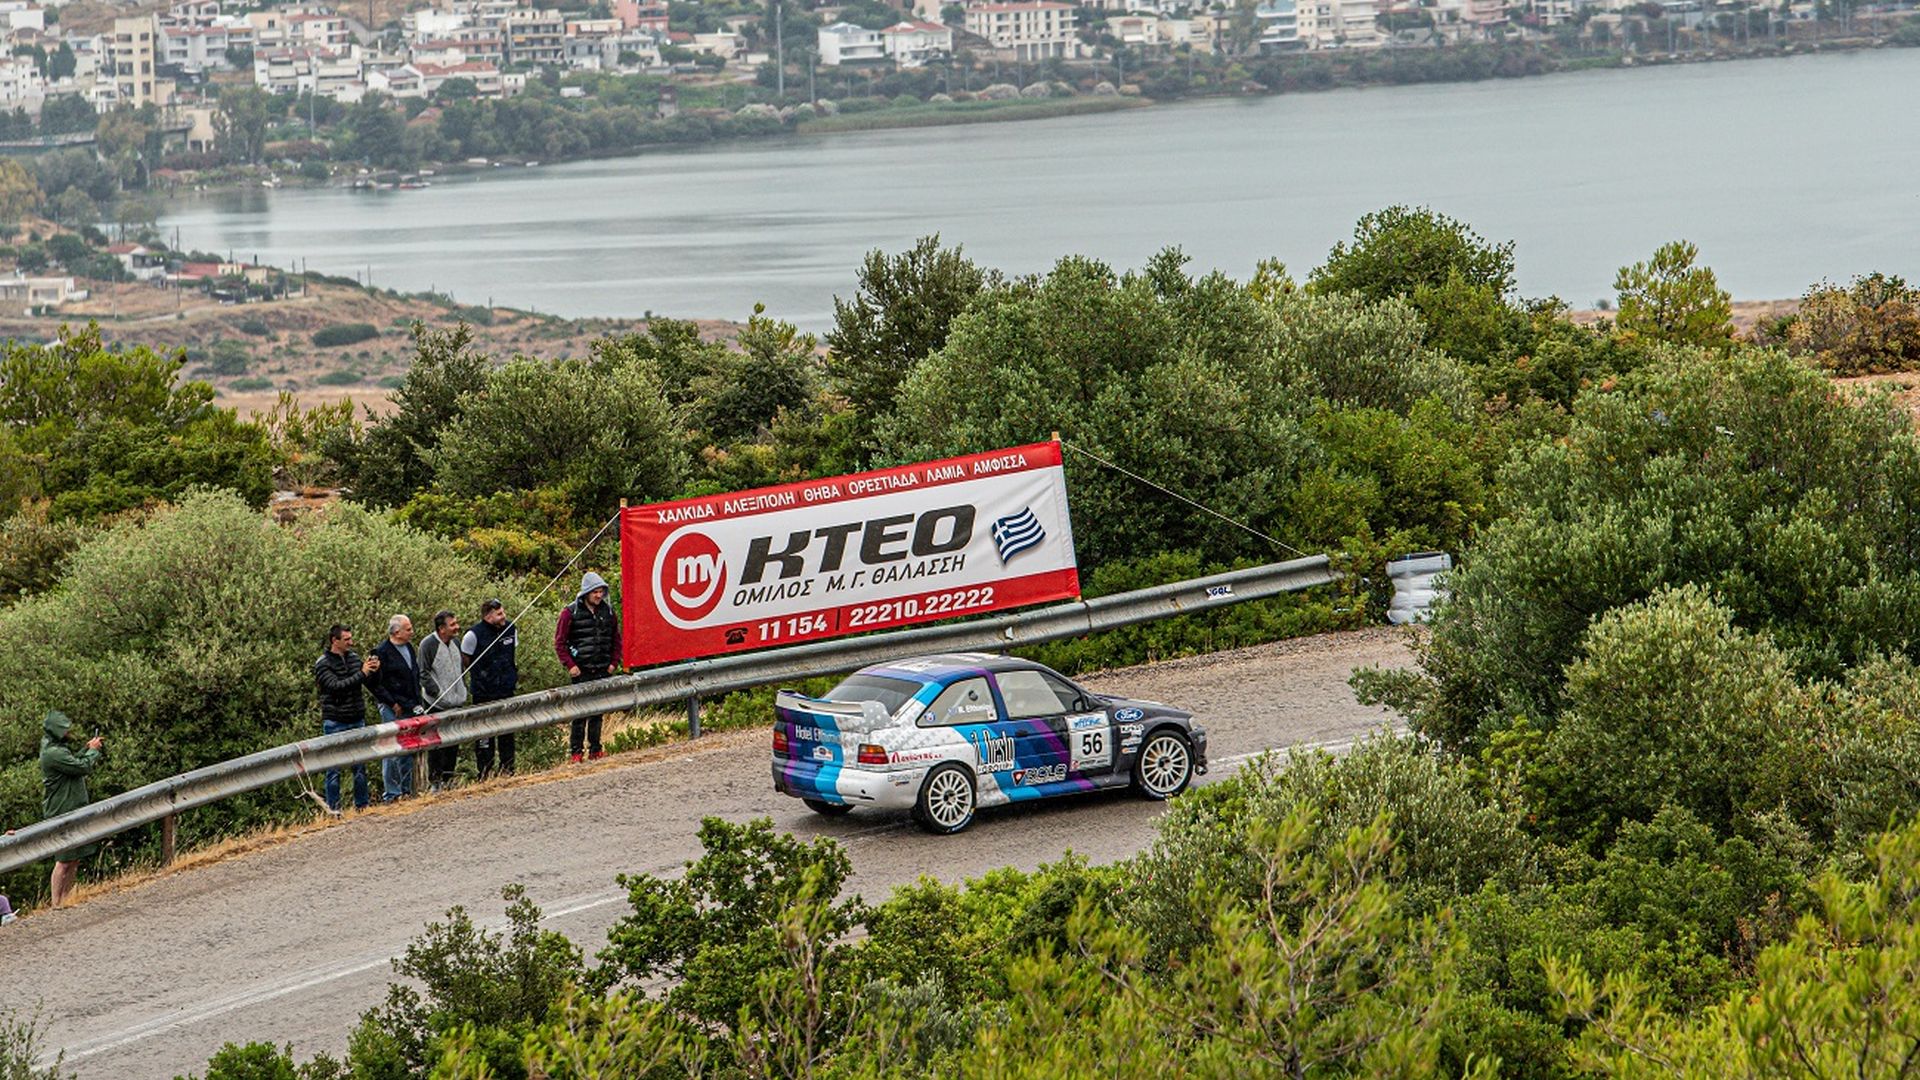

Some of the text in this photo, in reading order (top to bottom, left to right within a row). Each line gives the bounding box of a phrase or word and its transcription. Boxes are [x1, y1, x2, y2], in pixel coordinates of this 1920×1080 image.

[657, 453, 1027, 523] ΧΑΛΚΙΔΑ ΑΛΕΞ/ΠΟΛΗ ΘΗΒΑ ΟΡΕΣΤΙΑΔΑ ΛΑΜΙΑ ΑΜΦΙΣΣΑ
[739, 503, 977, 585] ΚΤΕΟ
[677, 552, 724, 585] my
[733, 579, 814, 606] ΟΜΙΛΟΣ
[872, 554, 966, 584] ΘΑΛΑΣΣΗ
[849, 587, 994, 627] 22210.22222
[795, 725, 813, 741] Hotel
[1082, 732, 1102, 755] 56
